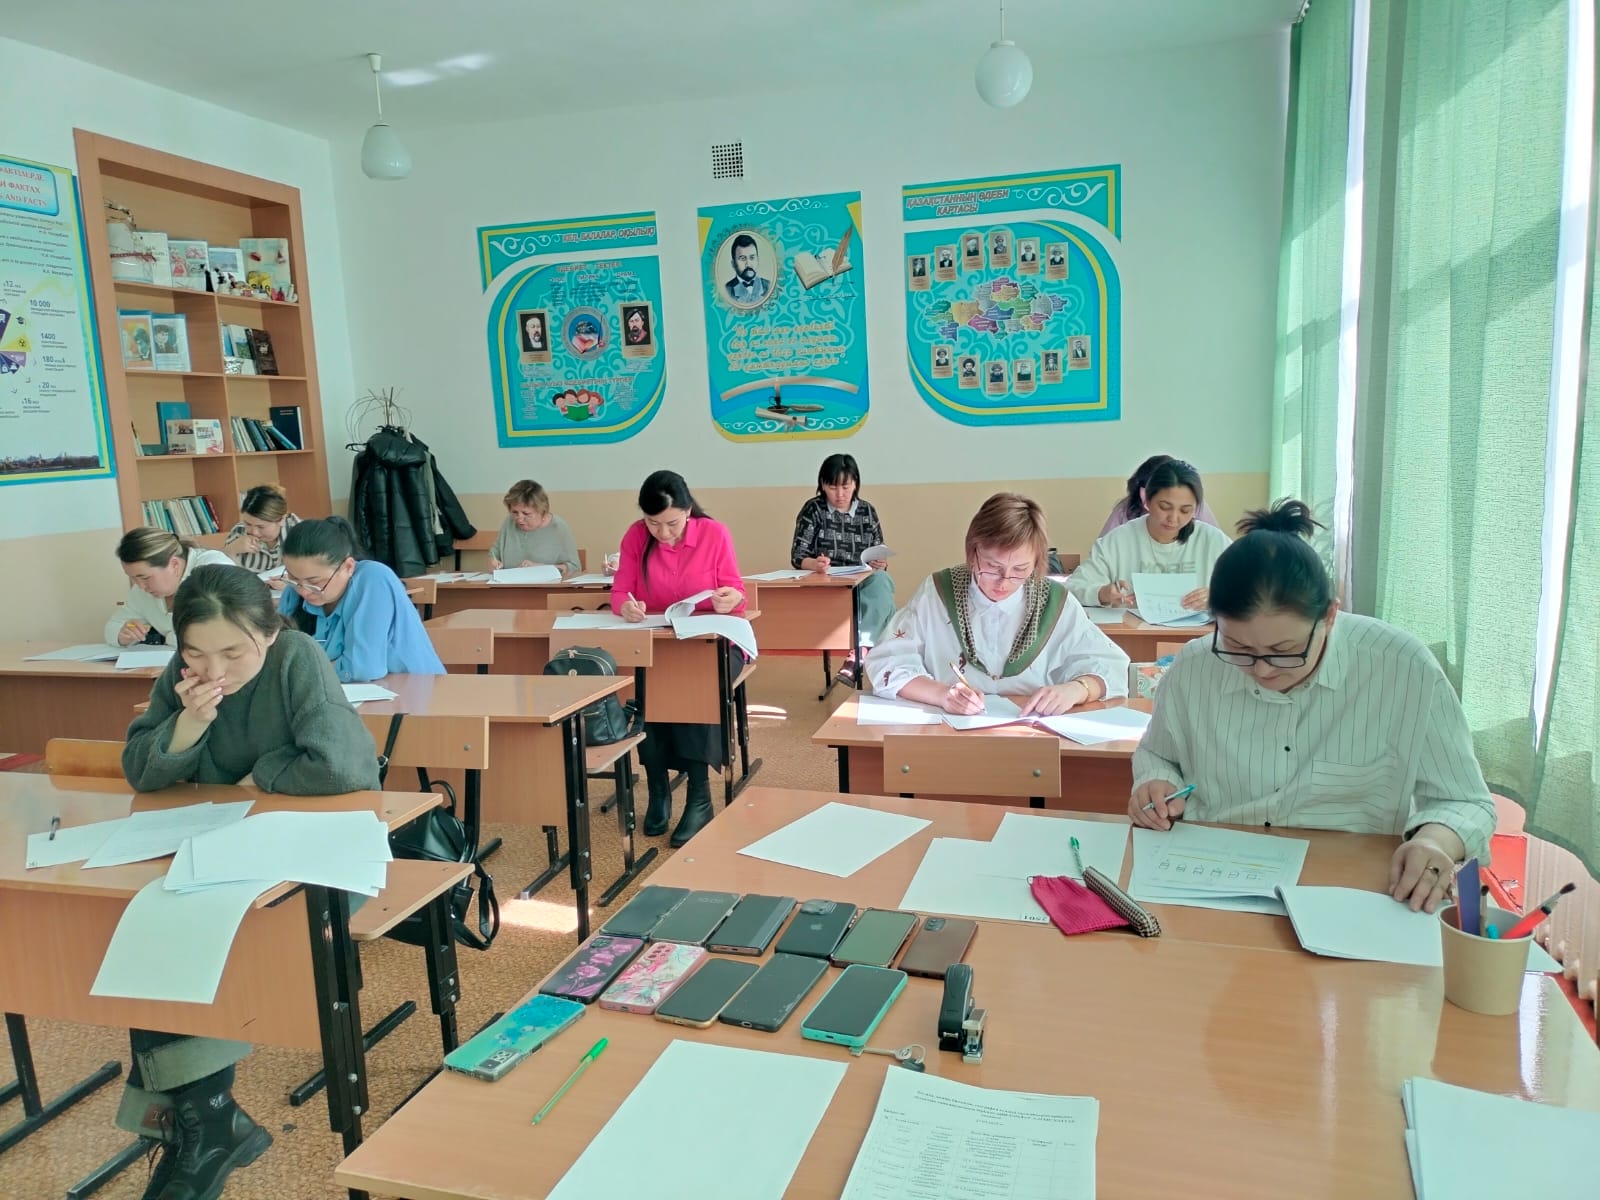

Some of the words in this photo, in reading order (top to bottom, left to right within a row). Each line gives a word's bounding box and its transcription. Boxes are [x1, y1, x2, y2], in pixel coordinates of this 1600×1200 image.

[8, 182, 40, 194] ФАКТАХ
[6, 193, 21, 201] AND
[23, 196, 47, 207] FACTS
[936, 202, 978, 216] КАРТАСЫ
